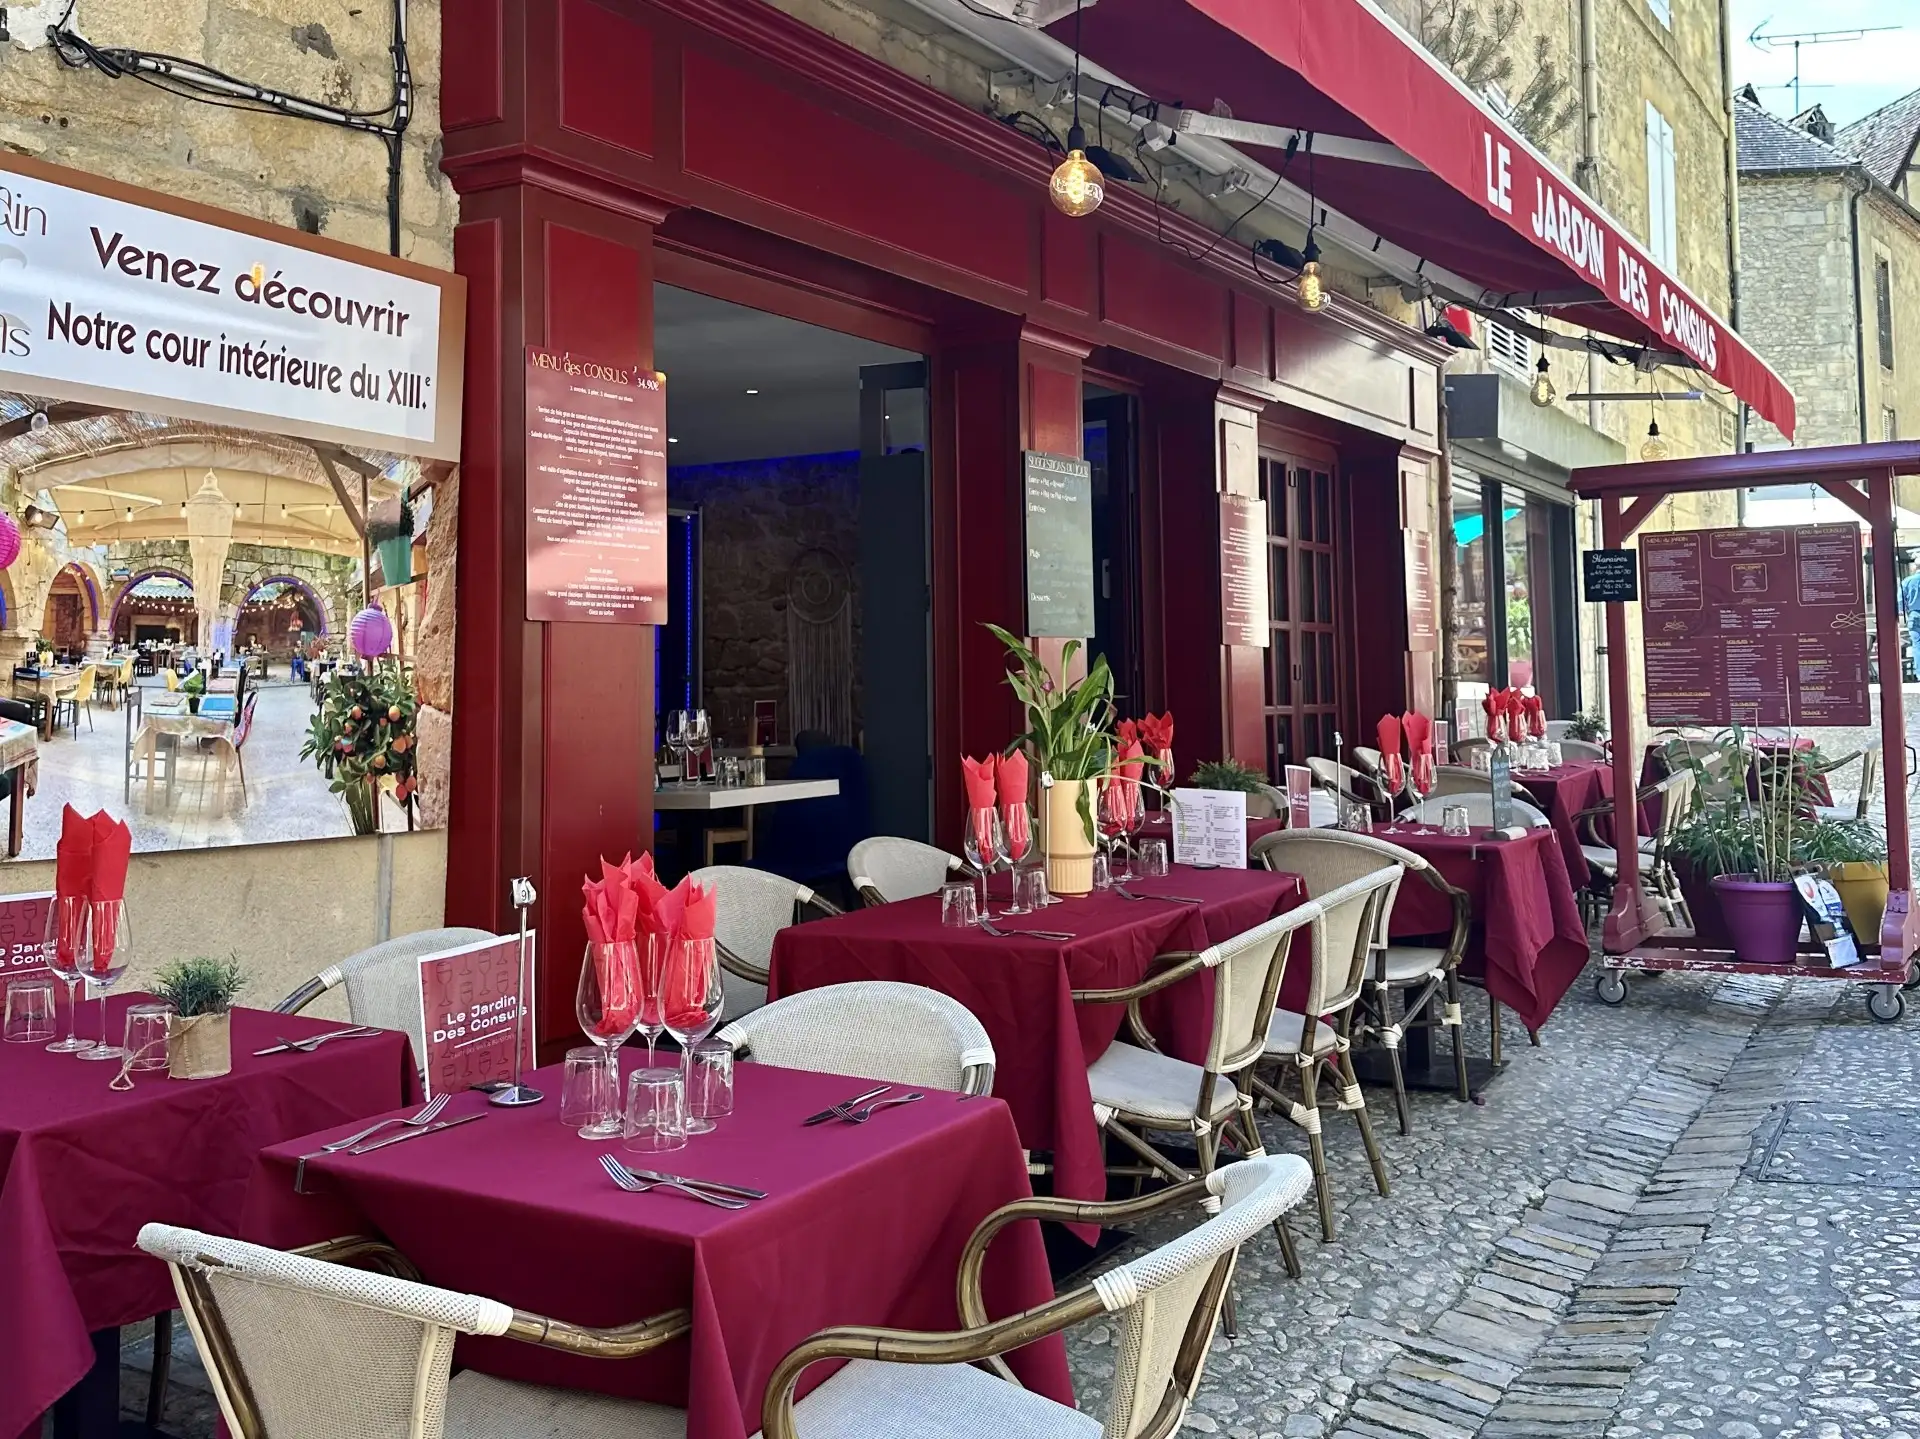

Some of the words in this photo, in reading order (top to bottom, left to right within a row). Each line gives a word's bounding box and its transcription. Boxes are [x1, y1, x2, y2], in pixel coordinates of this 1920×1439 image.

[90, 227, 220, 295] Venez
[235, 262, 410, 337] découvrir
[1484, 132, 1512, 215] LE
[1531, 176, 1606, 286] JARDIN
[1618, 247, 1650, 318] DES
[1660, 284, 1717, 371] CONSULS
[48, 299, 134, 354] Notre
[145, 329, 209, 368] cour
[219, 332, 341, 393] intérieure
[350, 363, 379, 401] du
[532, 352, 561, 371] MENU
[584, 363, 628, 385] CONSULS
[433, 1026, 466, 1043] Des
[447, 1012, 466, 1025] Le
[471, 995, 516, 1018] Jardin
